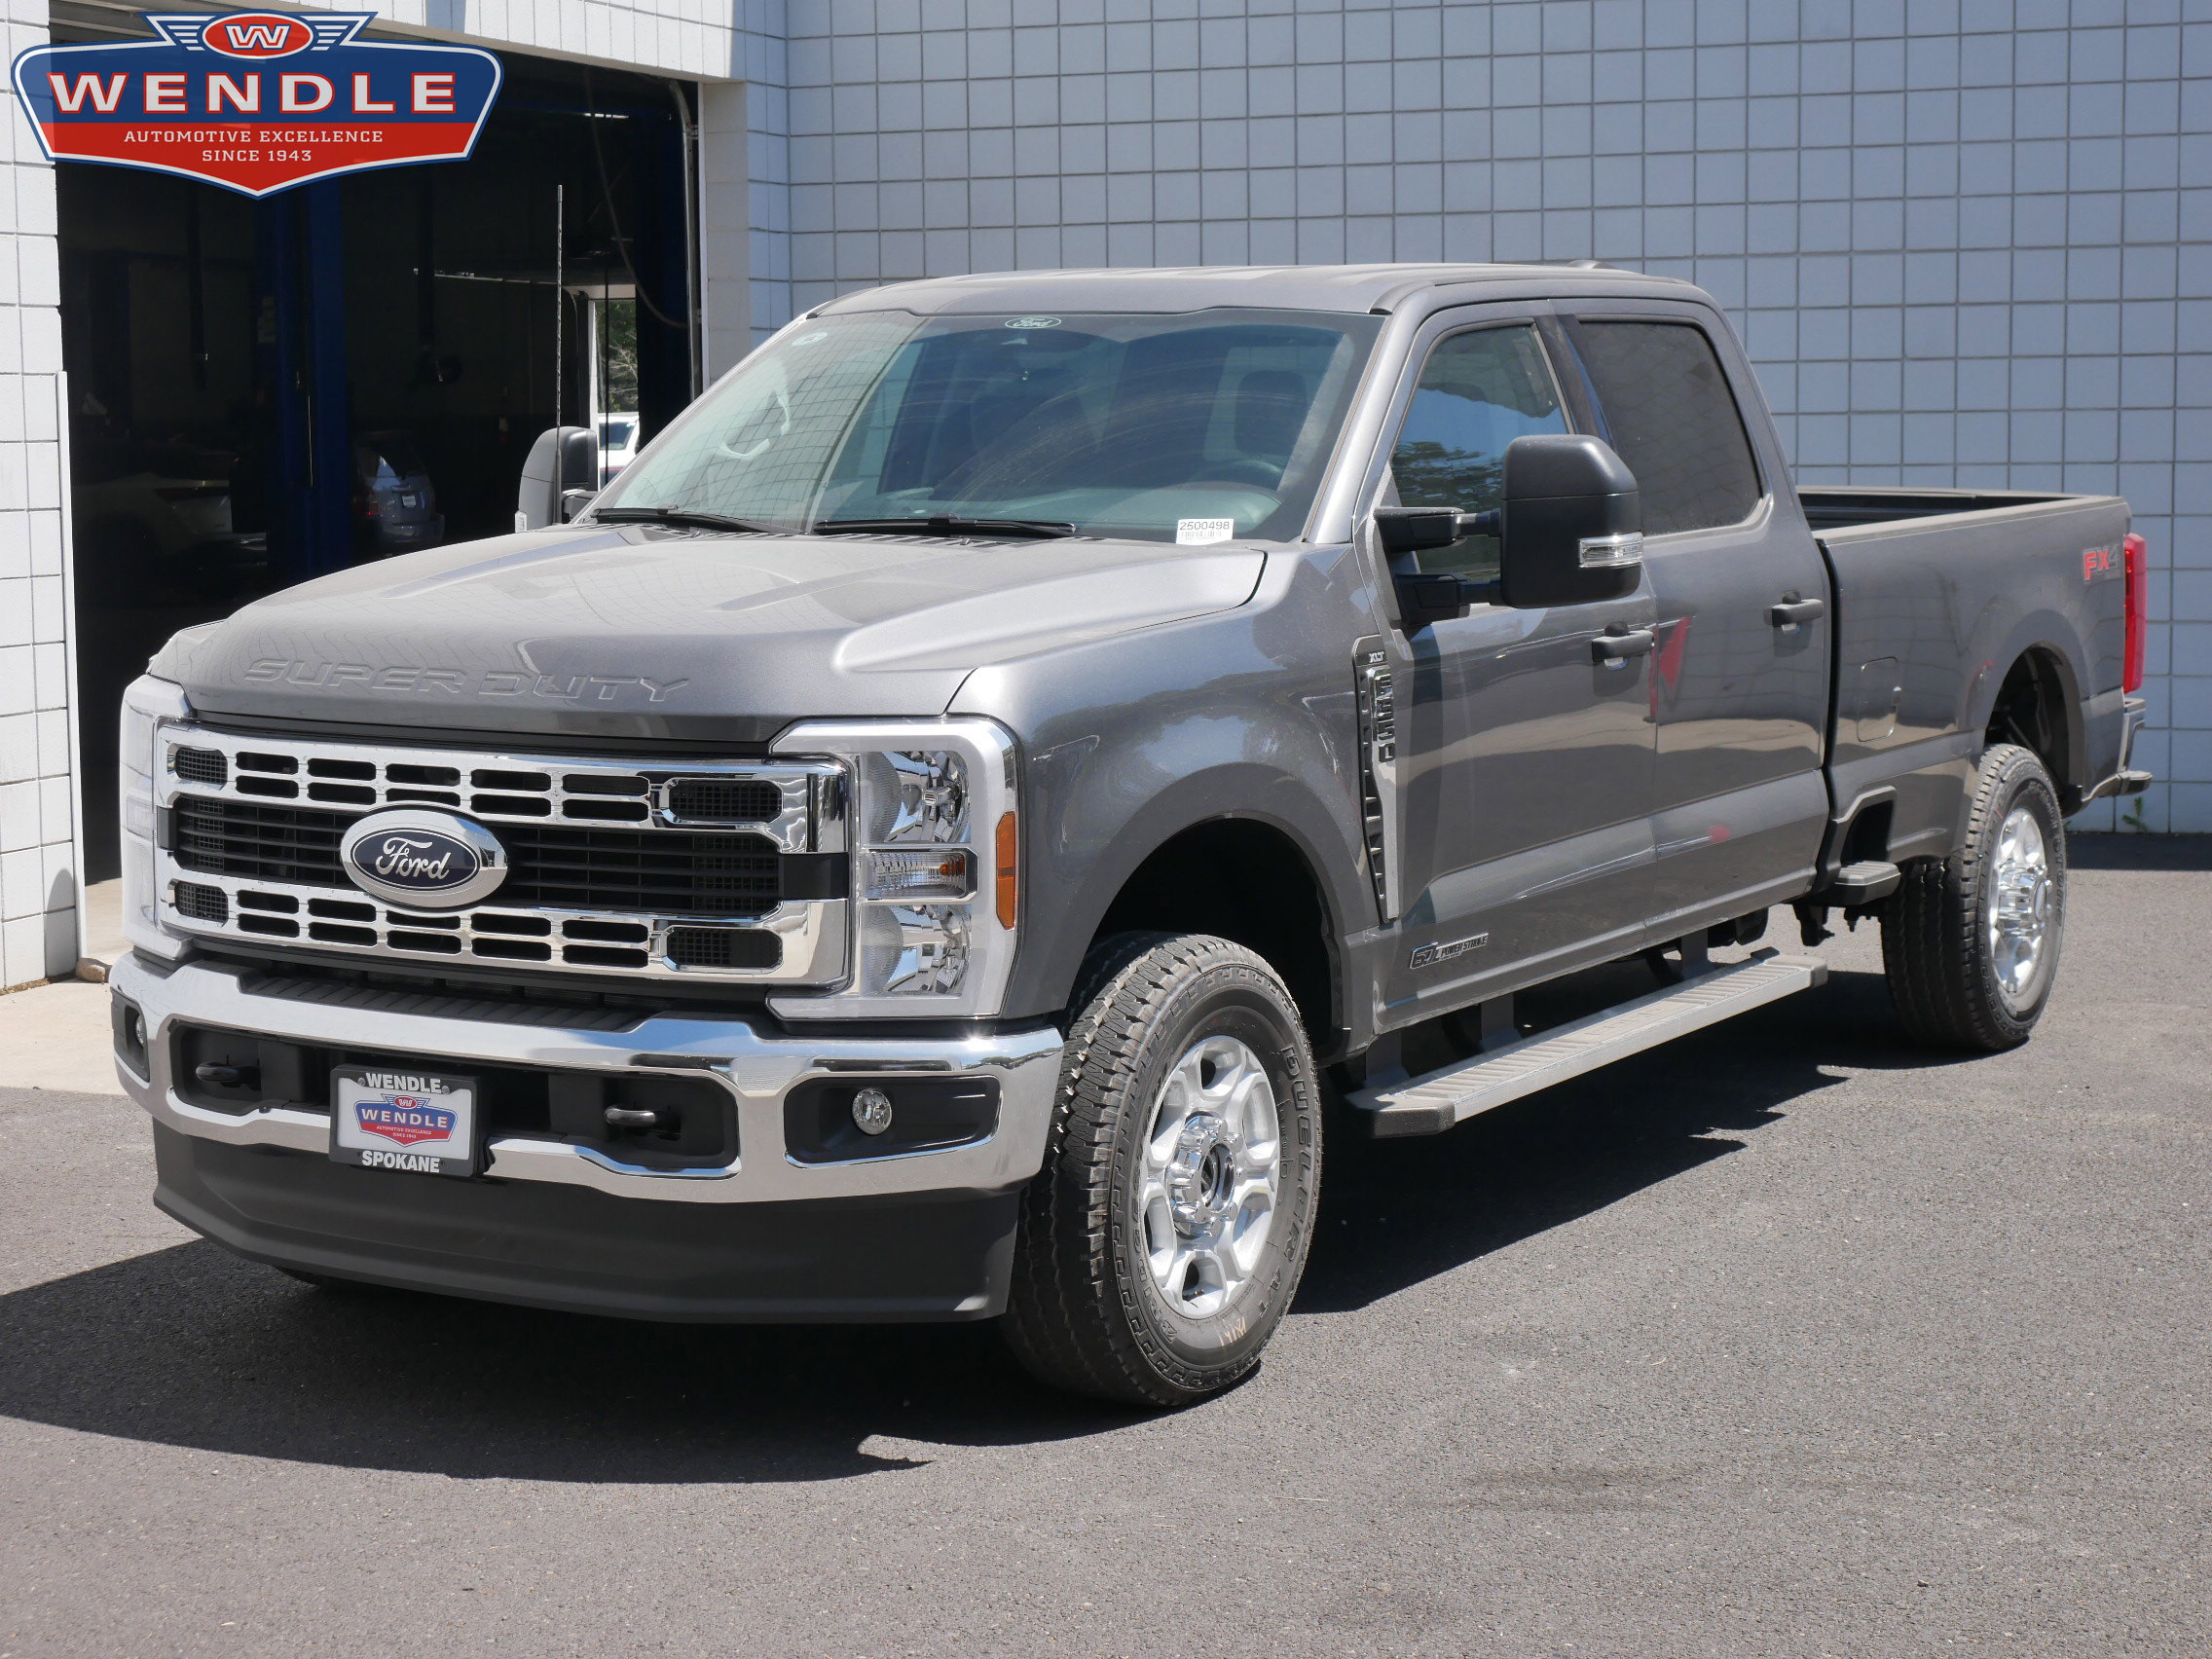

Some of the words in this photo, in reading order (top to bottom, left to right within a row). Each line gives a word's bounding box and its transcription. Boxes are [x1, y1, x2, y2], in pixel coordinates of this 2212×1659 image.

[1014, 317, 1053, 328] Ford
[1179, 521, 1231, 531] 2500498
[2083, 545, 2120, 583] FX4
[1368, 651, 1385, 663] XLT
[244, 658, 468, 693] SUPER
[478, 670, 689, 702] DUTY
[375, 836, 452, 880] Ford
[365, 1072, 442, 1094] WENDLE
[361, 1108, 449, 1128] WENDLE
[361, 1150, 441, 1173] SPOKANE
[1280, 1045, 1312, 1262] DUELER
